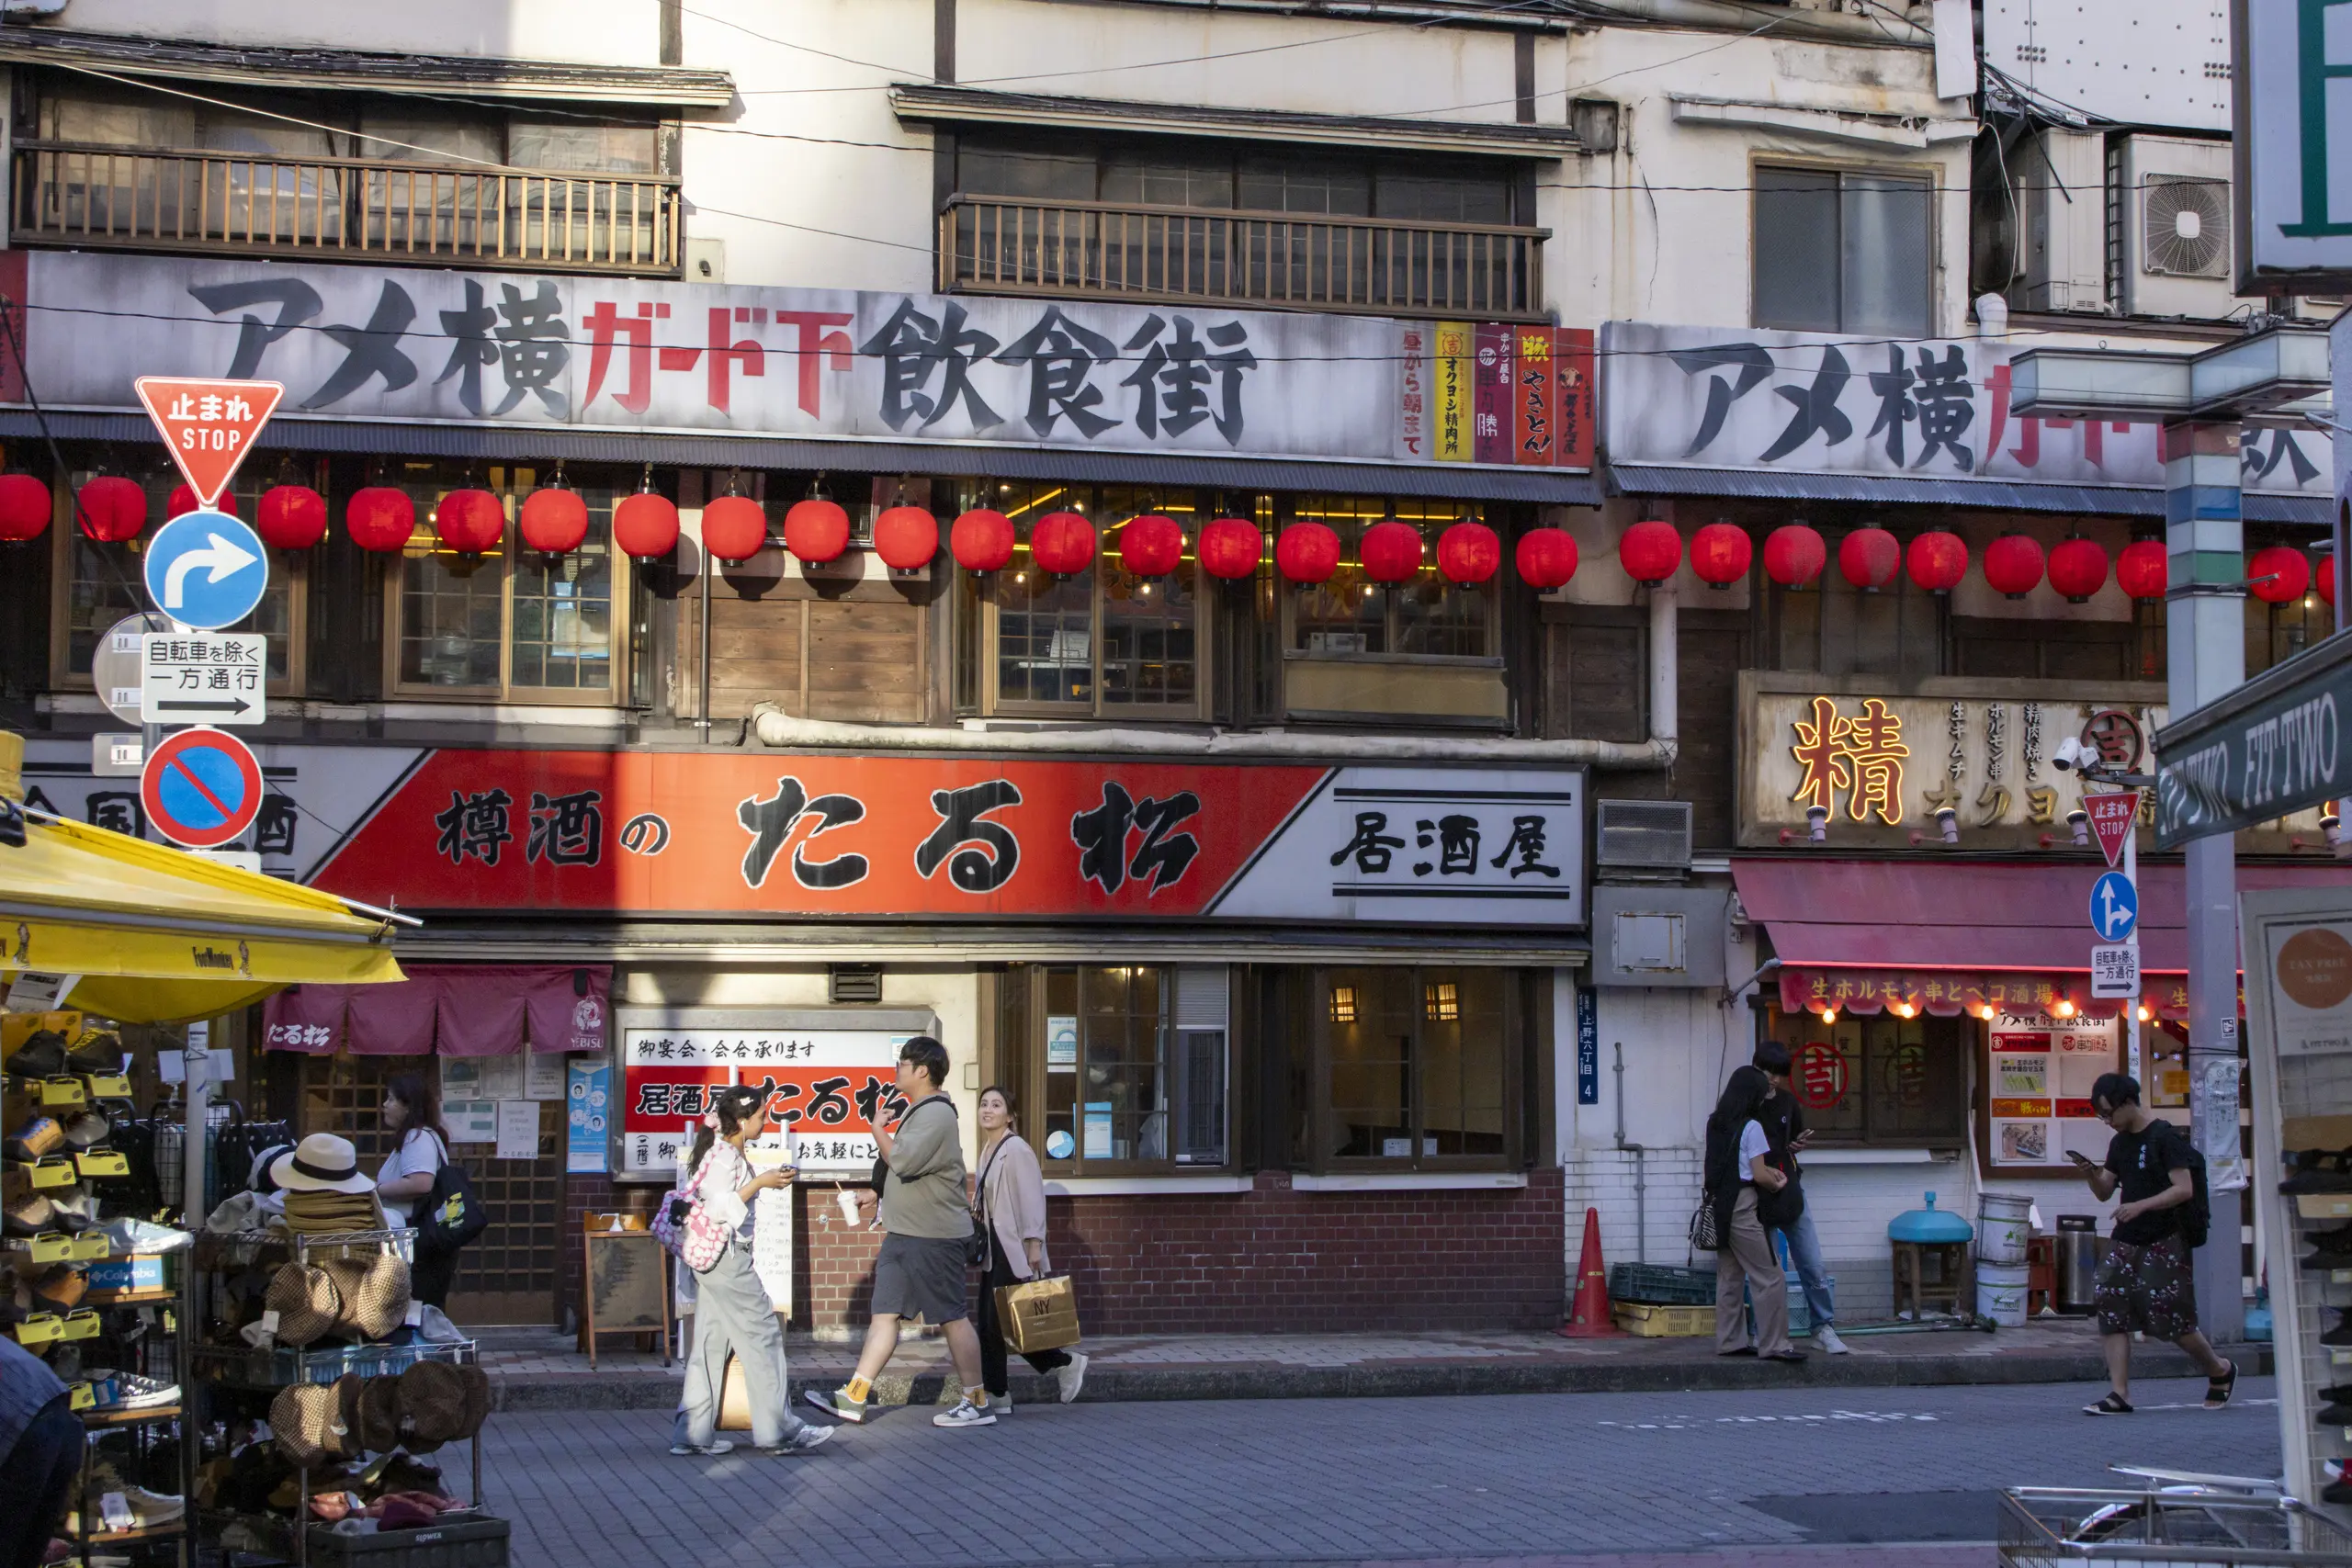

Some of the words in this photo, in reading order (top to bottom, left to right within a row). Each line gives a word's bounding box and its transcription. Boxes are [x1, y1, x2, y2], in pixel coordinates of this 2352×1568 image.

[168, 394, 254, 423] 止まれ
[182, 427, 241, 452] STOP
[150, 640, 259, 663] 自転車を除く
[150, 668, 259, 691] 一方通行
[1949, 701, 1967, 780] 生キムチ
[1988, 703, 2005, 780] ホルモン串
[2024, 703, 2043, 782] 精肉焼き
[2095, 801, 2129, 818] 止まれ
[2100, 821, 2125, 836] STOP
[1330, 811, 1561, 879] 居酒屋
[2096, 951, 2135, 964] 自転車を除く
[2096, 965, 2135, 979] 一方通行
[266, 1023, 331, 1046] たる松
[571, 1037, 605, 1048] YEBISU
[1583, 1015, 1593, 1075] 上野六丁目
[1584, 1085, 1592, 1097] 4
[1034, 1298, 1050, 1316] NY
